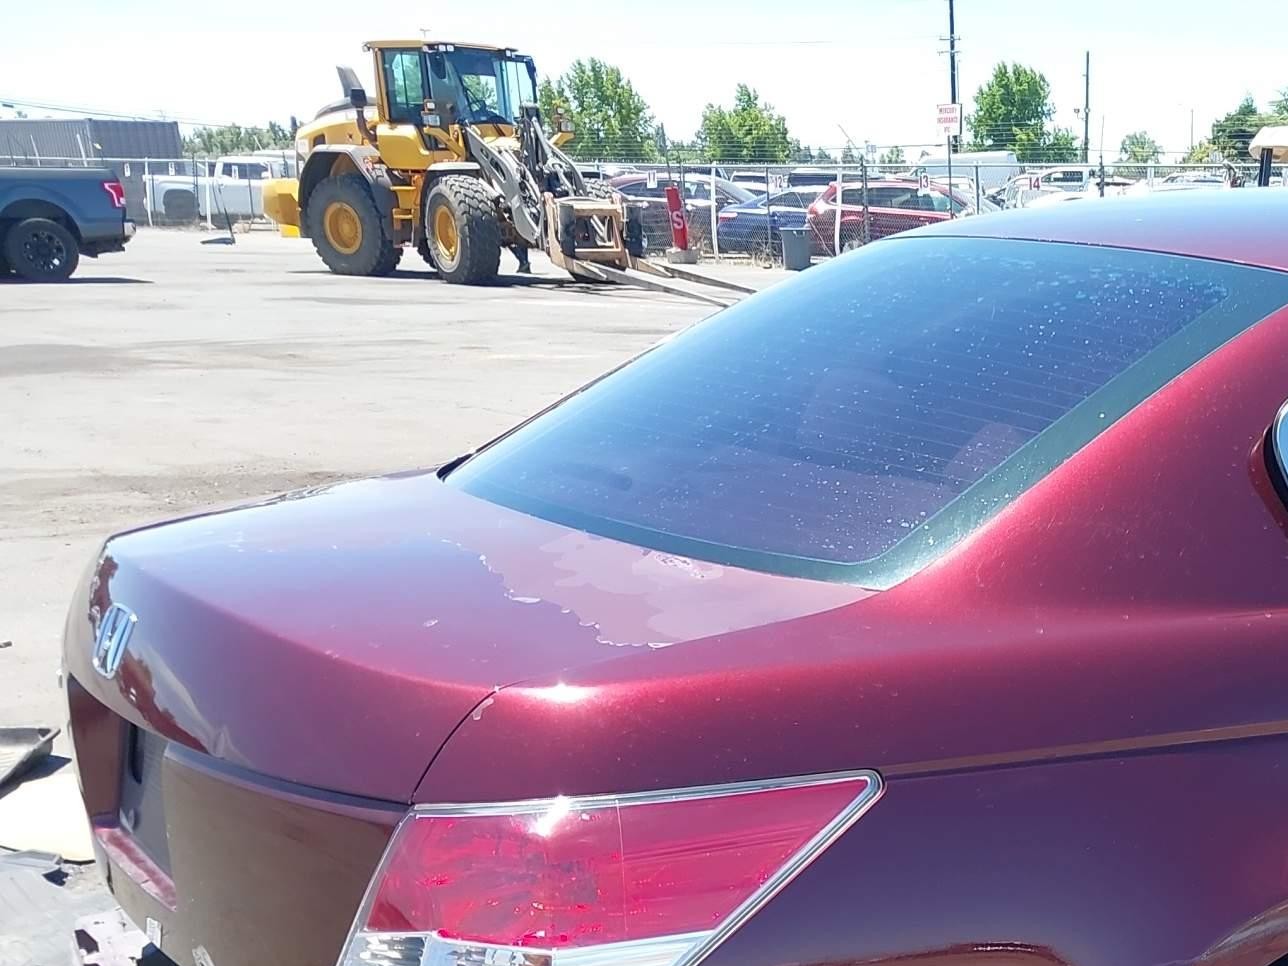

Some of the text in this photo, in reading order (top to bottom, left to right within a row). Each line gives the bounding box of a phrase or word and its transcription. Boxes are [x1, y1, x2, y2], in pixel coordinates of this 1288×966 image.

[919, 174, 929, 189] 13
[1029, 176, 1041, 191] 14
[671, 210, 685, 229] S
